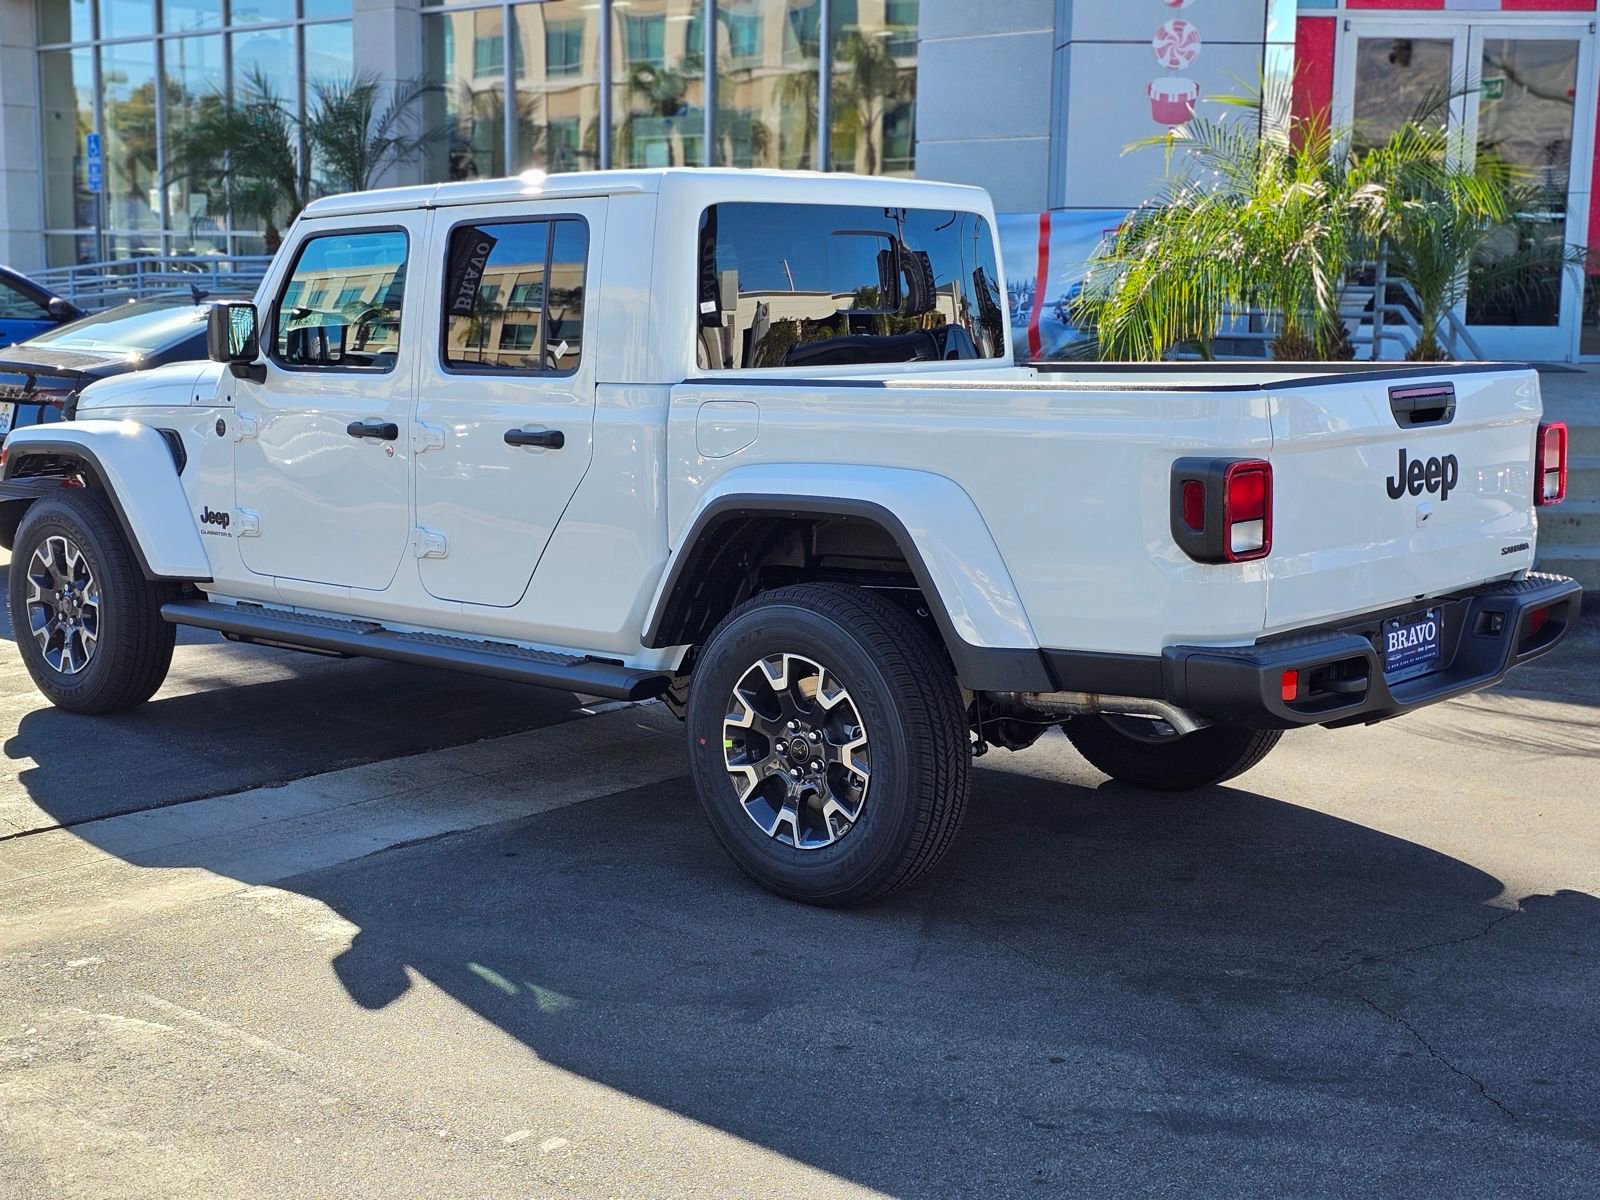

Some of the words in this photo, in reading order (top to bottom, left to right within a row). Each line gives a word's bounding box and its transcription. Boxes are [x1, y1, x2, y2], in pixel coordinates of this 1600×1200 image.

[1386, 448, 1458, 501] Jeep
[200, 506, 230, 529] Jeep
[1388, 622, 1436, 653] BRAVO
